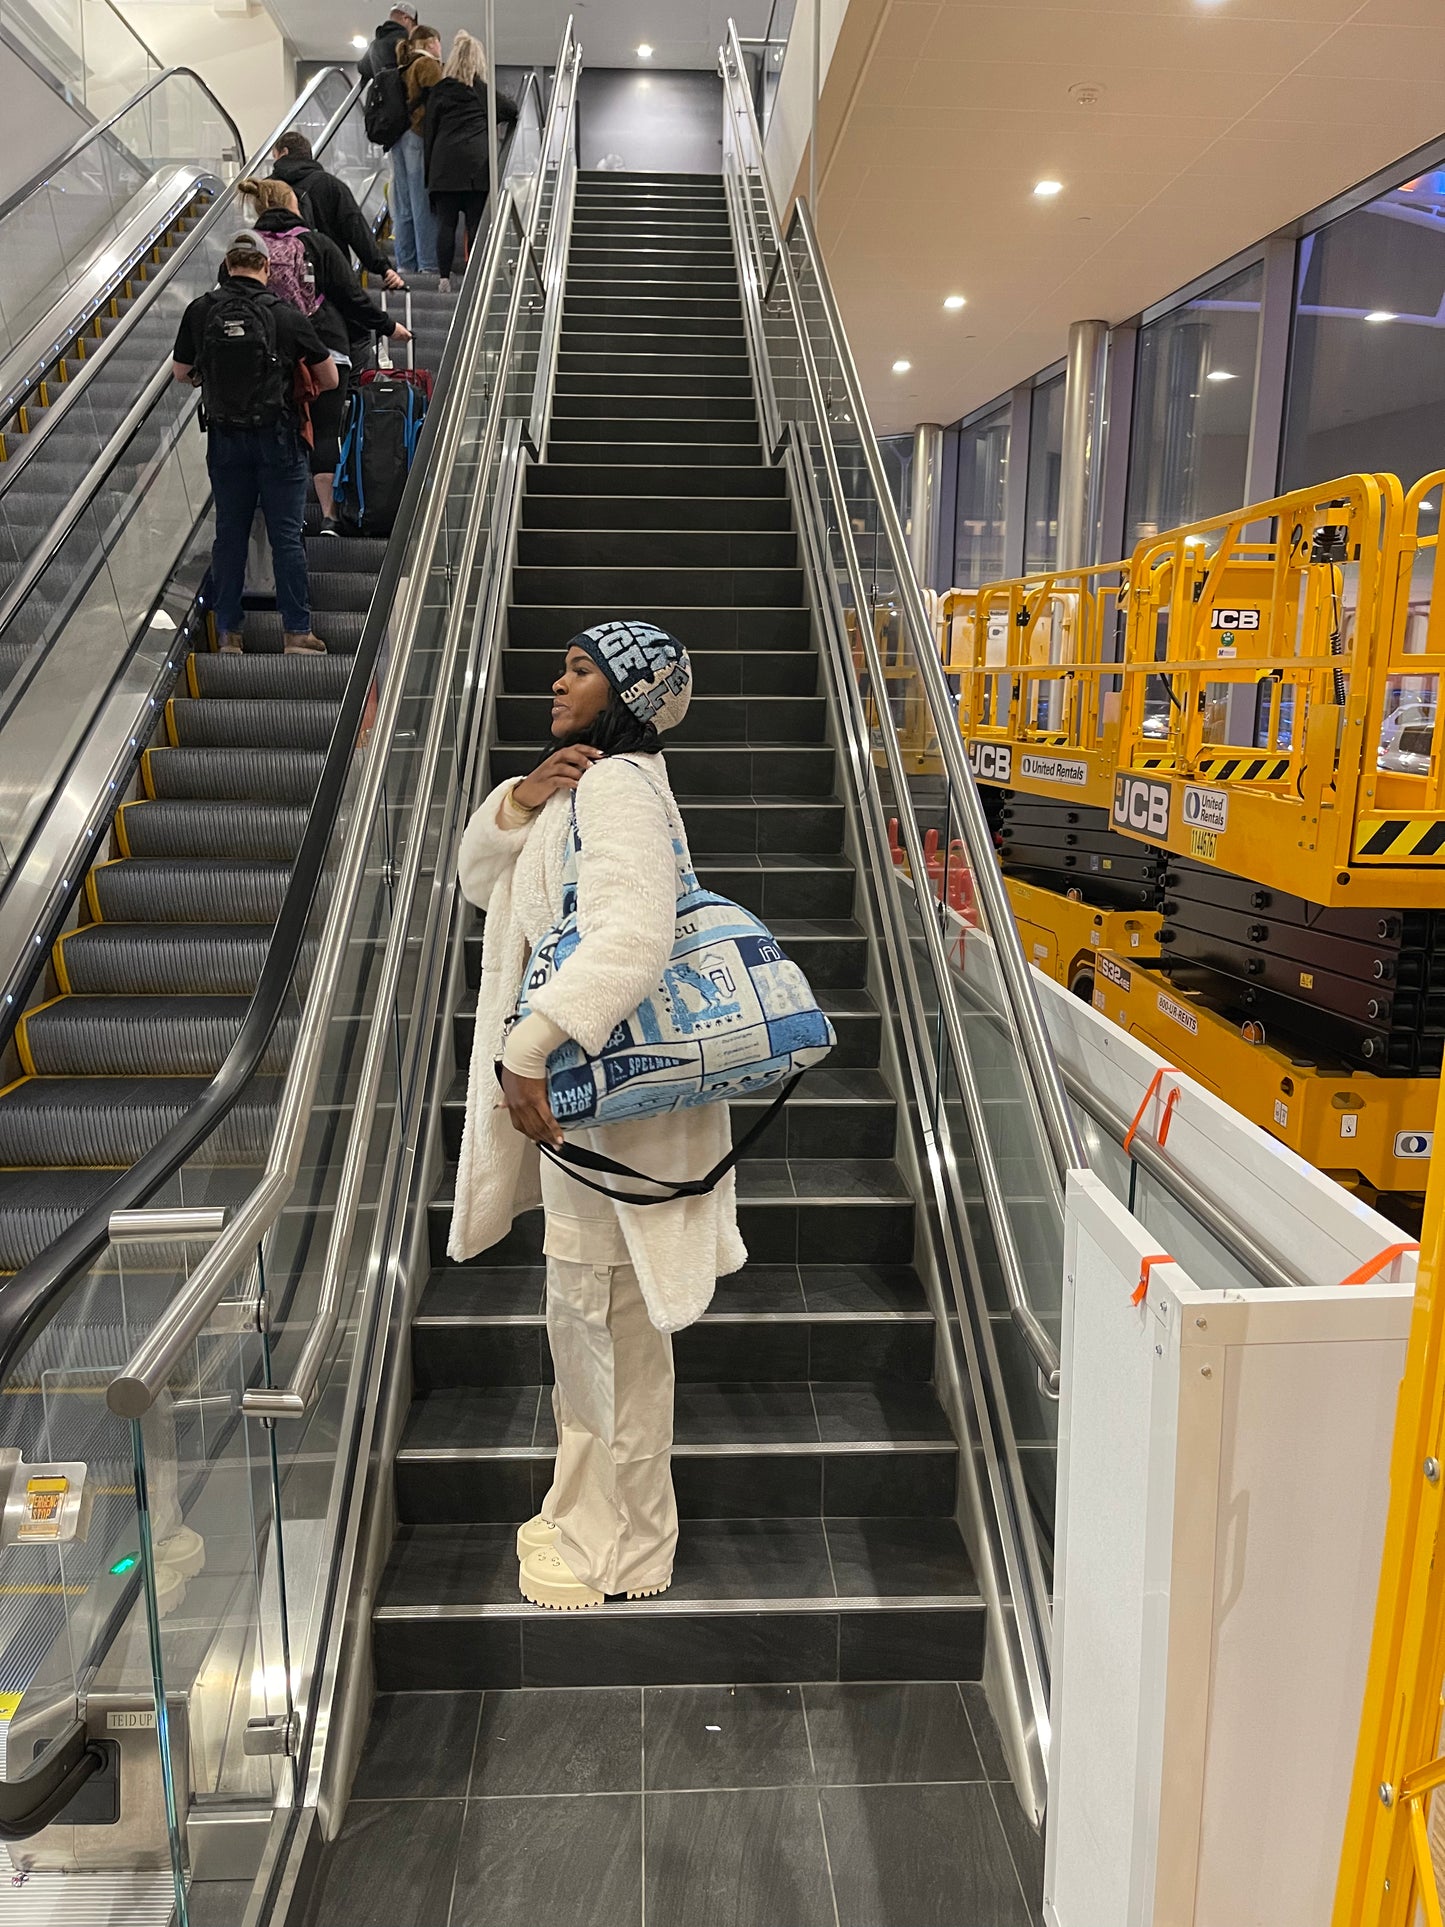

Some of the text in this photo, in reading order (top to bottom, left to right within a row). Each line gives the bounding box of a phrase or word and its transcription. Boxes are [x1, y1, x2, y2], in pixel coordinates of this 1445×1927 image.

[1211, 610, 1259, 629] JCB
[968, 744, 1012, 780] JCB
[1032, 760, 1084, 780] United Rentals
[1114, 779, 1169, 835] JCB
[1201, 794, 1224, 811] United
[1200, 809, 1224, 826] Rentals
[1158, 997, 1197, 1030] 800-UR-RENTS
[112, 1713, 153, 1726] TEID UP
